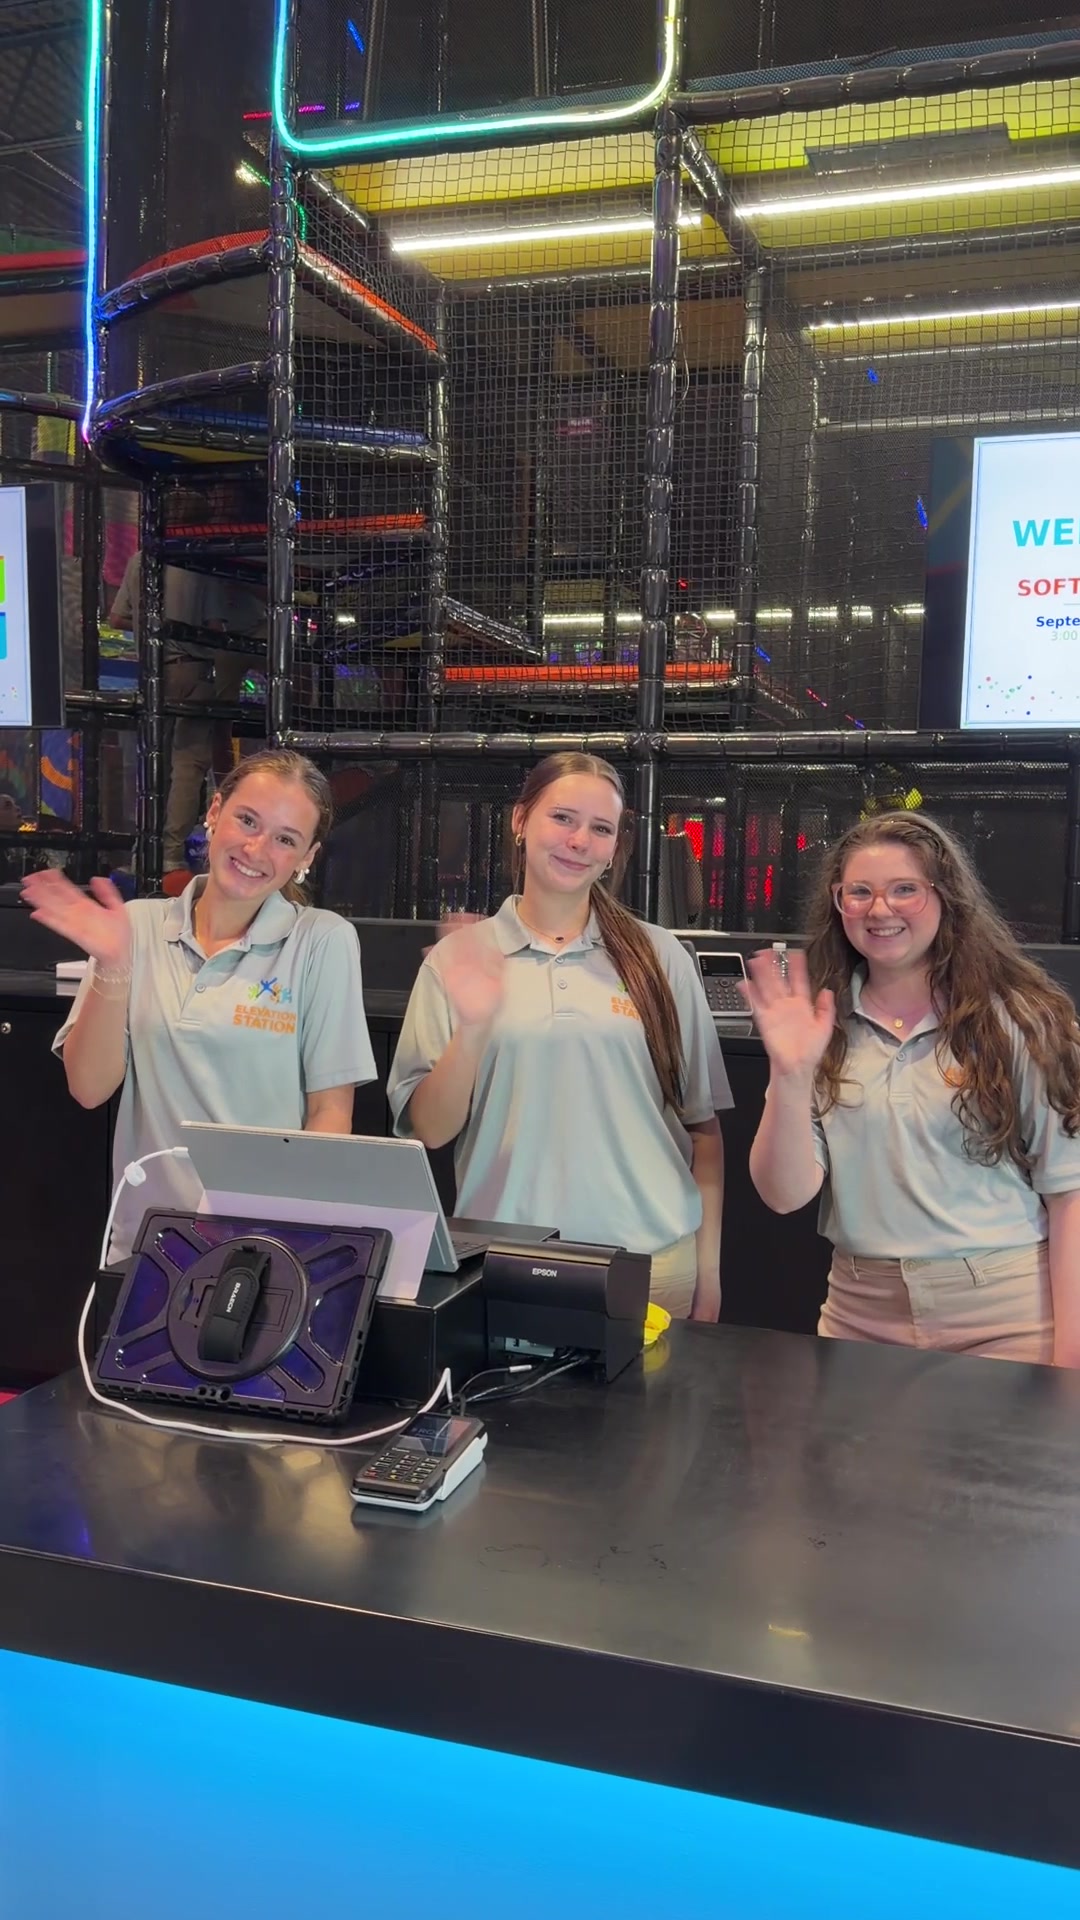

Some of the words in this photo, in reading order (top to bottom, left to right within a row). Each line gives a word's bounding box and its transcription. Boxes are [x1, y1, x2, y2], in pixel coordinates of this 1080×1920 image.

[1012, 517, 1080, 547] WE
[1017, 577, 1080, 597] SOFT
[1035, 615, 1080, 629] Septe
[1051, 630, 1078, 641] 3:00
[234, 1004, 297, 1021] ELEVATION
[233, 1013, 295, 1034] STATION
[532, 1268, 557, 1277] EPSON
